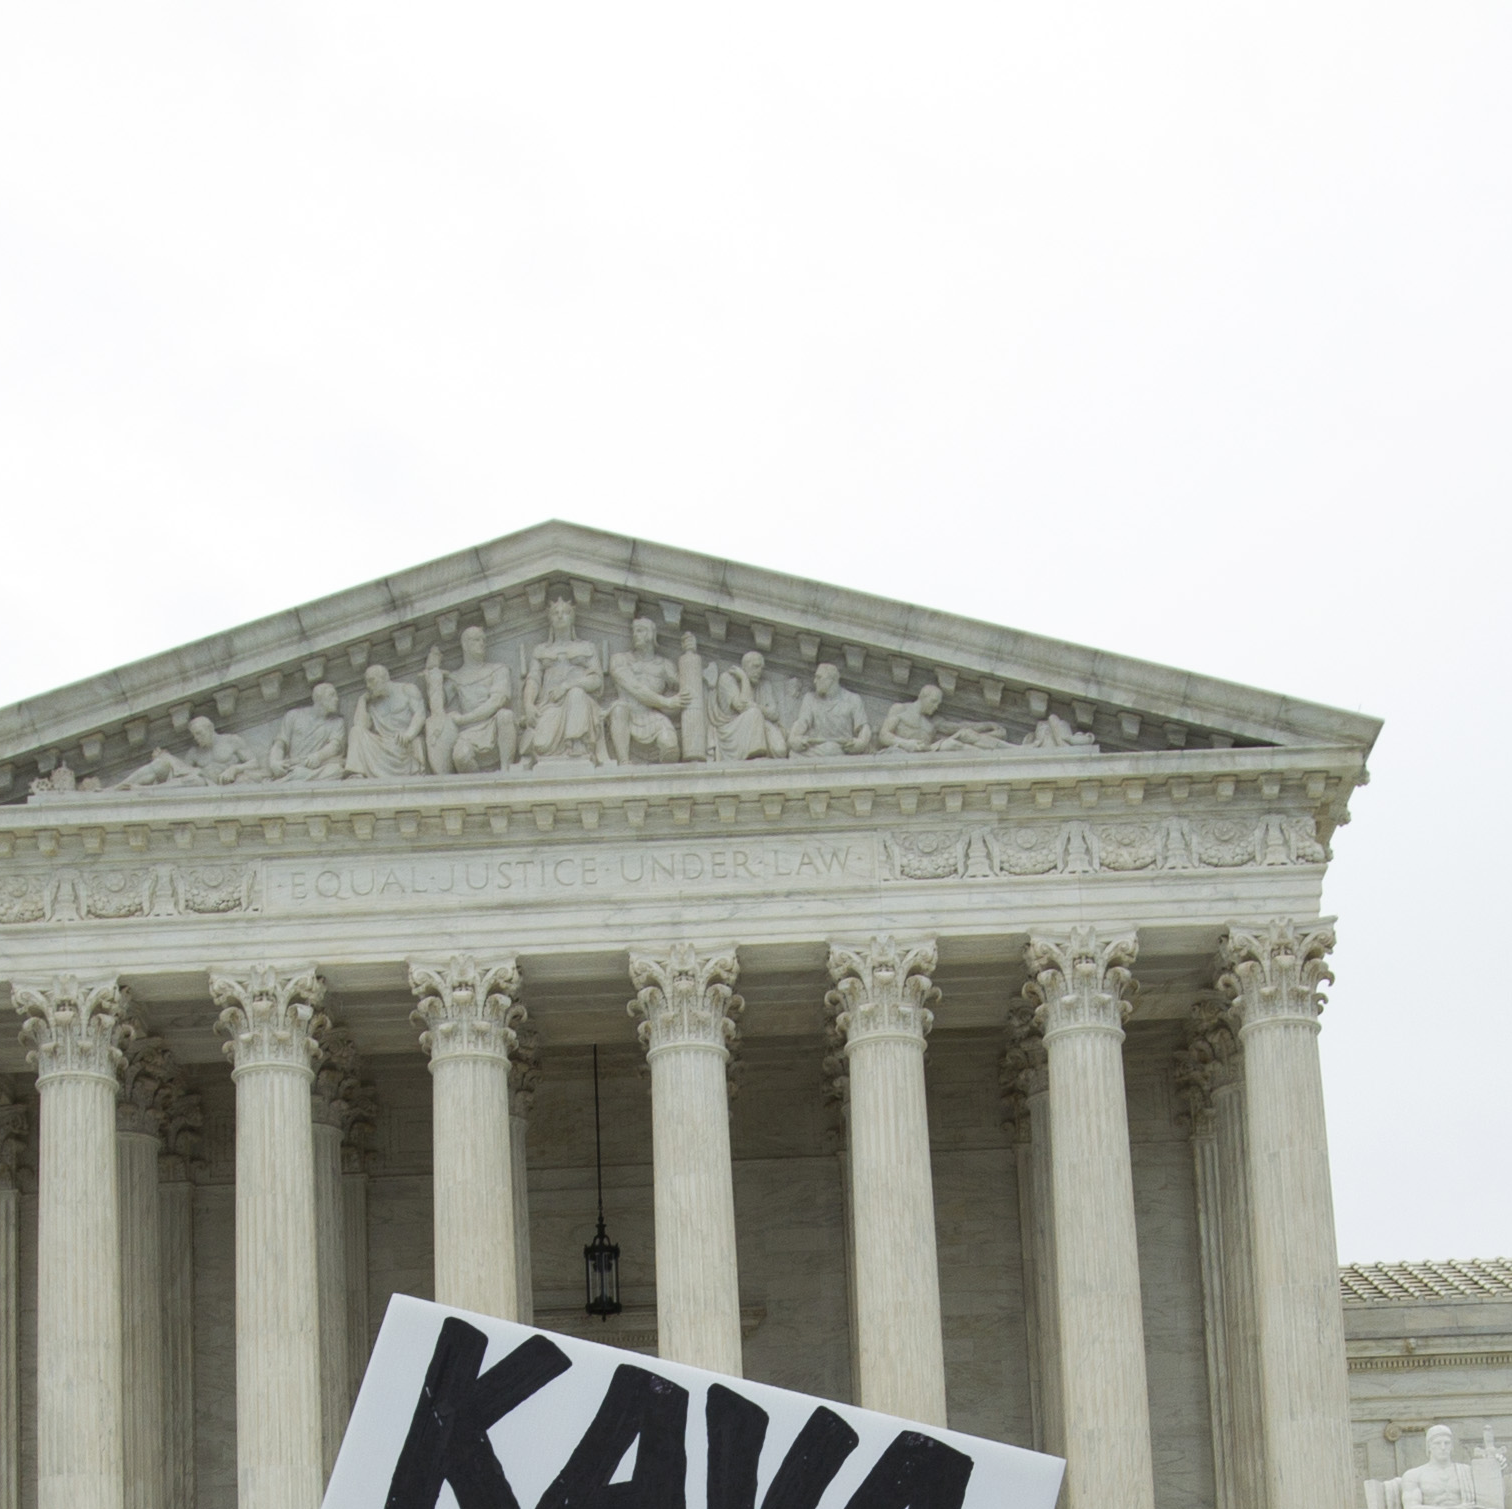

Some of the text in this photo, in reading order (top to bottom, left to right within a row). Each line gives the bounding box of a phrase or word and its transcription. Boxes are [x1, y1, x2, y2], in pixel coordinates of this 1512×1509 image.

[290, 846, 852, 900] EQUAL JUSTICE UNDER LAW
